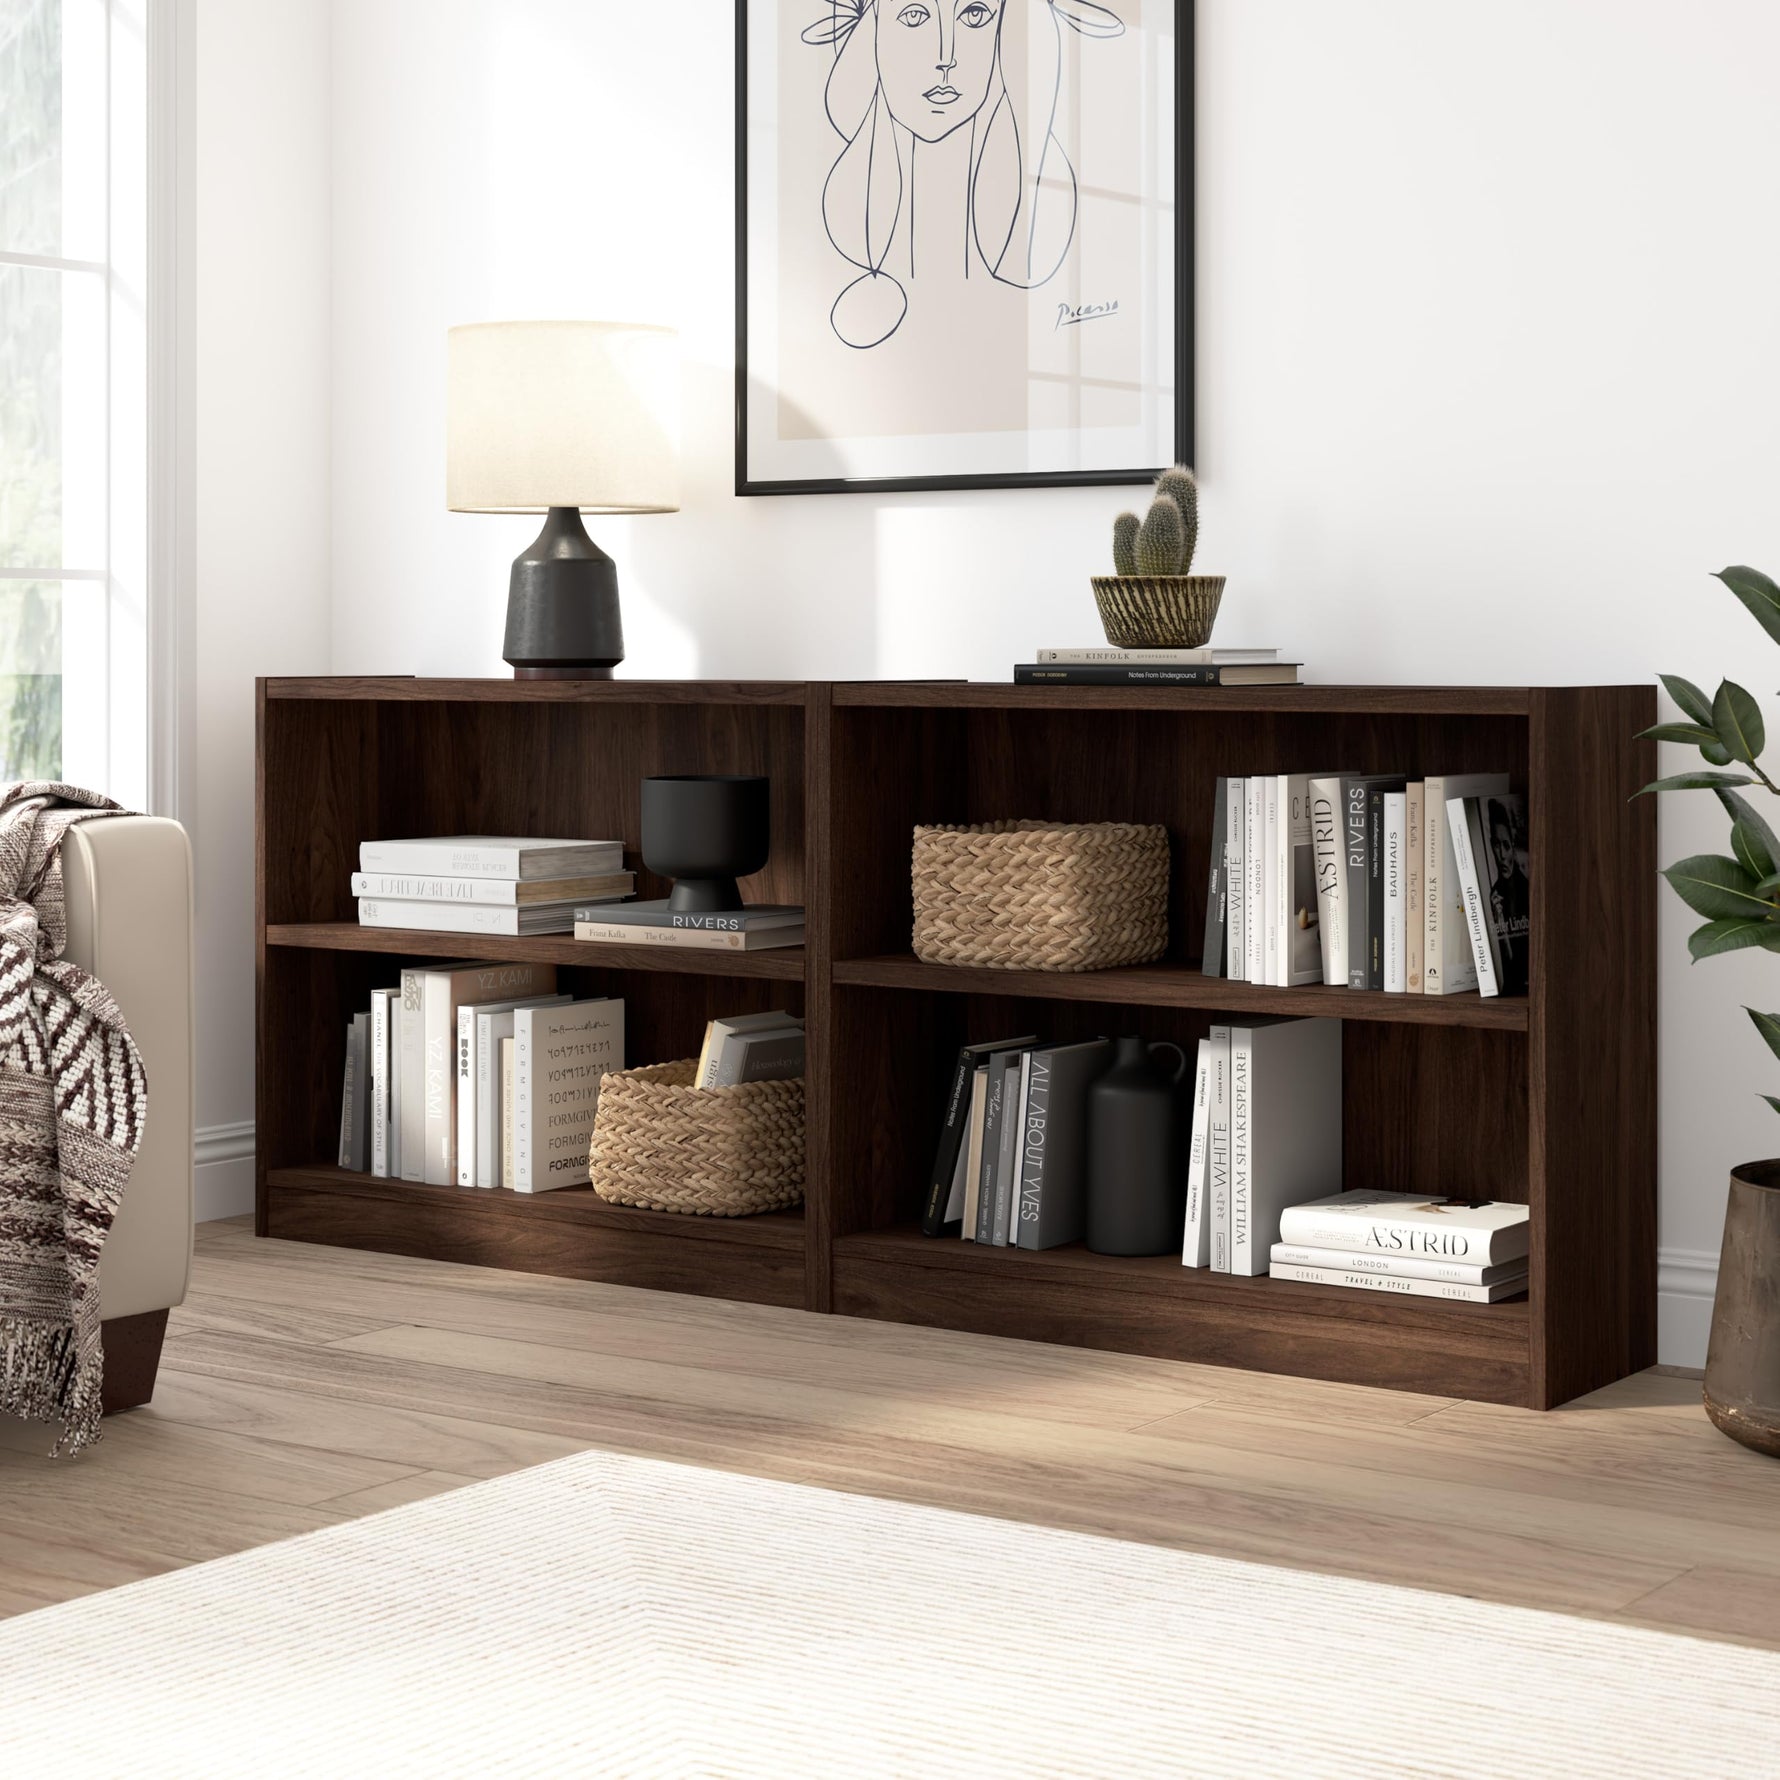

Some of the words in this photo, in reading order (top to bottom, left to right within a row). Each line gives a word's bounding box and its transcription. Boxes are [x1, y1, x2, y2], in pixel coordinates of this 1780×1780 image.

[1085, 652, 1131, 660] KINFOLK
[1159, 672, 1197, 680] Underground
[1350, 788, 1365, 867] RIVERS
[1230, 857, 1242, 911] WHITE
[1429, 877, 1437, 932] KINFOLK
[1466, 886, 1482, 942] Lindbergh
[607, 929, 626, 939] Kafka
[672, 915, 739, 930] RIVERS
[1477, 944, 1488, 973] Peter
[500, 968, 532, 986] KAMI
[706, 1060, 718, 1088] sign
[1030, 1061, 1050, 1095] ALL
[428, 1068, 443, 1118] KAMI
[548, 1108, 597, 1128] FORMGIVI
[1236, 1052, 1247, 1165] SHAKESPEARE
[376, 1119, 382, 1129] OF
[1026, 1102, 1047, 1169] ABOUT
[1213, 1122, 1227, 1187] WHITE
[1021, 1177, 1041, 1222] YVES
[1236, 1171, 1246, 1246] WILLIAM
[1296, 1271, 1324, 1282] CEREAL
[1353, 1259, 1389, 1269] LONDON
[1345, 1276, 1373, 1286] TRAVEL
[1386, 1281, 1411, 1290] STYLE
[1442, 1288, 1472, 1298] CEREAL
